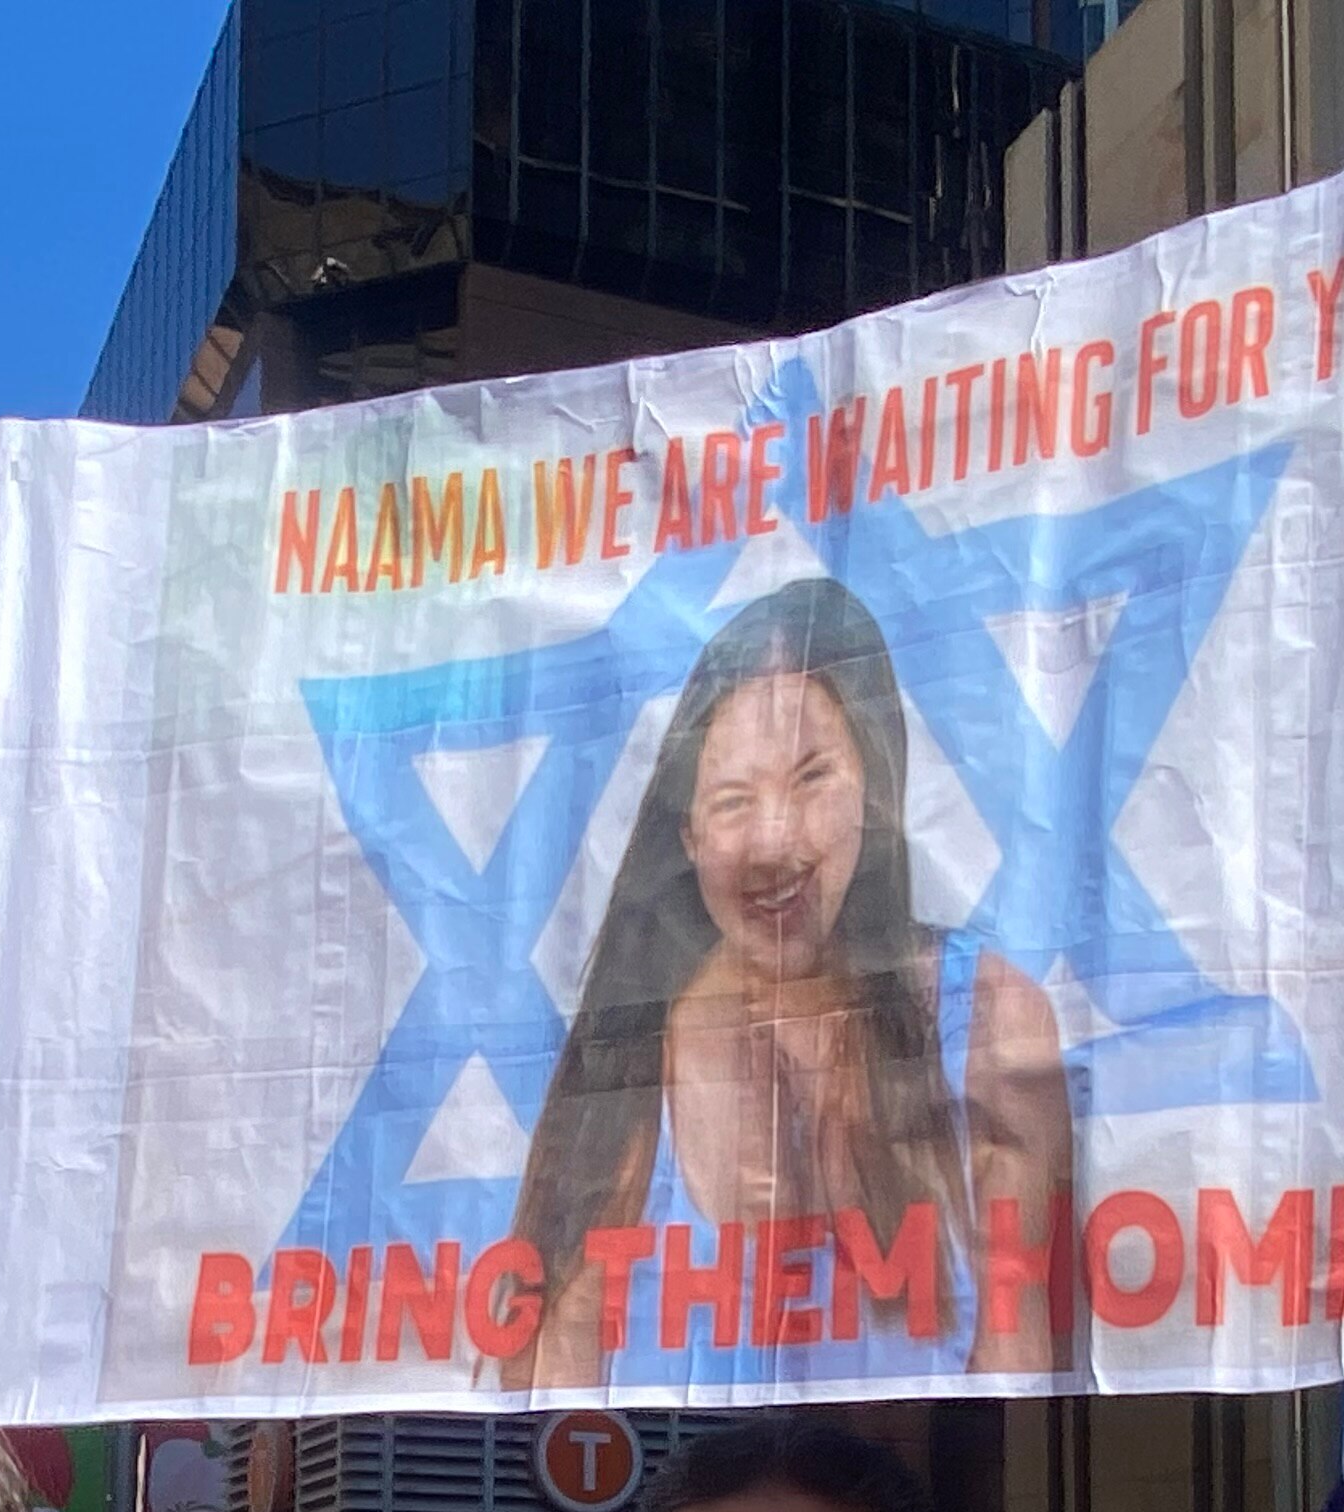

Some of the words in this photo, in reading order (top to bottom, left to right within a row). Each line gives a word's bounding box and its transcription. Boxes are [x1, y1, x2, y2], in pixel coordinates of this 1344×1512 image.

[278, 468, 506, 594] NAAMA
[534, 447, 636, 569] WE
[656, 424, 783, 551] ARE
[807, 340, 1114, 525] WAITING
[1137, 286, 1274, 436] FOR
[187, 1238, 544, 1366] BRING
[582, 1201, 939, 1350] THEM
[569, 1432, 611, 1492] T
